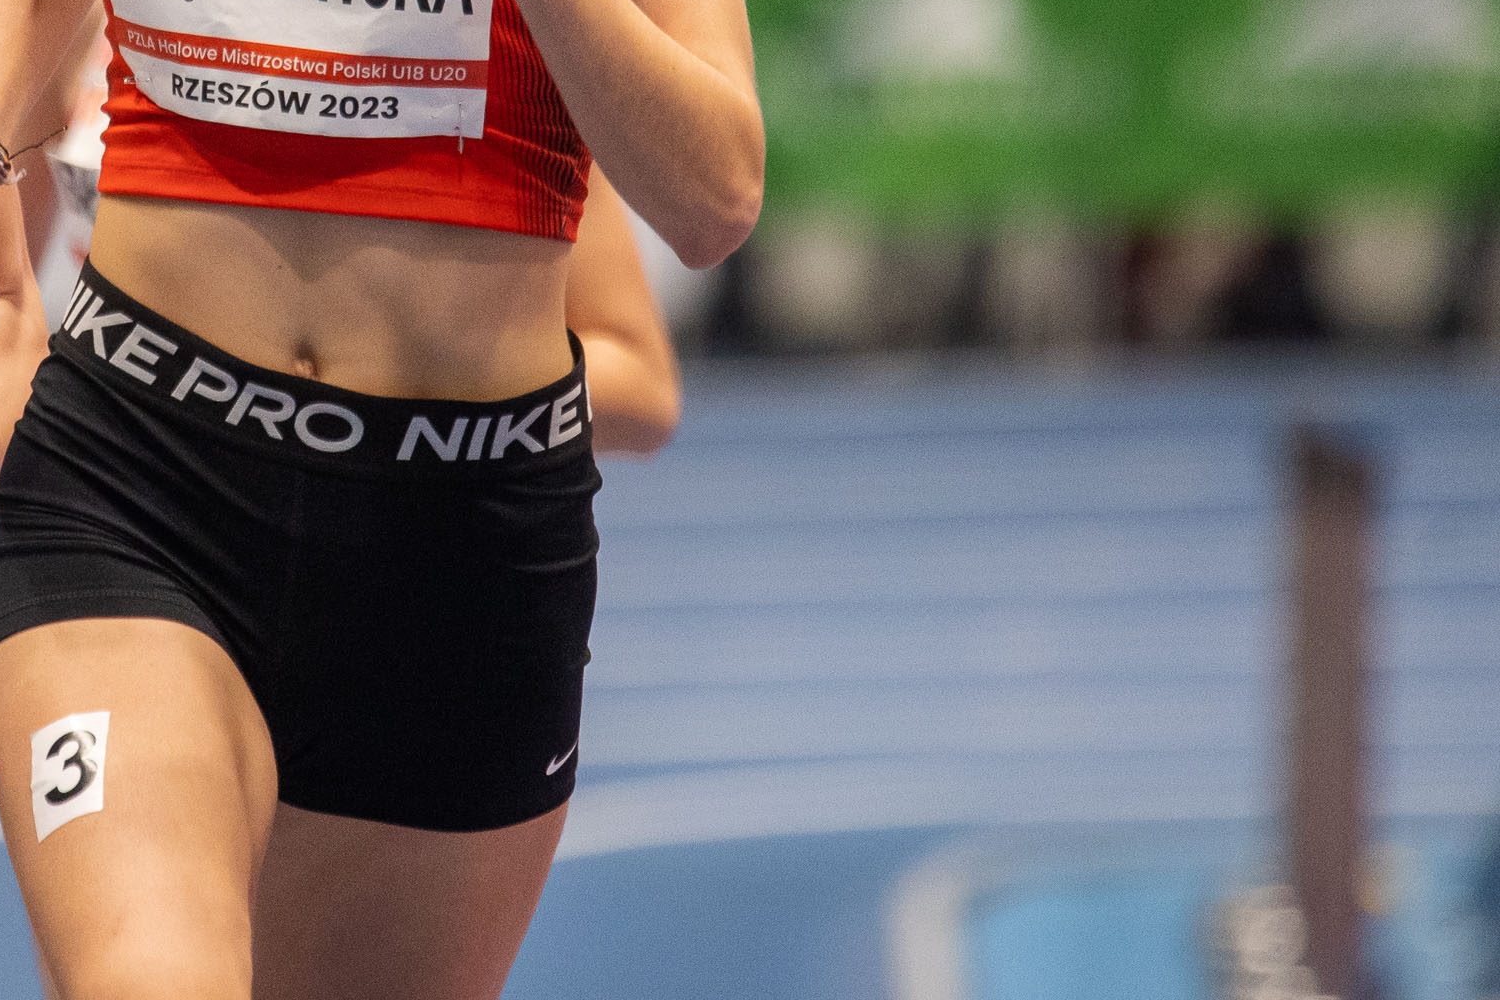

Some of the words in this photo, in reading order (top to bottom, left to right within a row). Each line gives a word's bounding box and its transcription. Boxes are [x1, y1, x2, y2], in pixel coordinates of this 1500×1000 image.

[127, 29, 155, 50] PZLA
[158, 39, 217, 61] Halowe
[222, 47, 327, 76] Mistrzostwa
[333, 62, 386, 80] Polski
[392, 65, 424, 81] U18
[430, 66, 466, 81] U20
[171, 72, 311, 115] RZESZÓW
[319, 94, 399, 120] 2023
[171, 357, 364, 453] PRO
[396, 382, 582, 461] NIKE
[45, 731, 98, 806] 3
